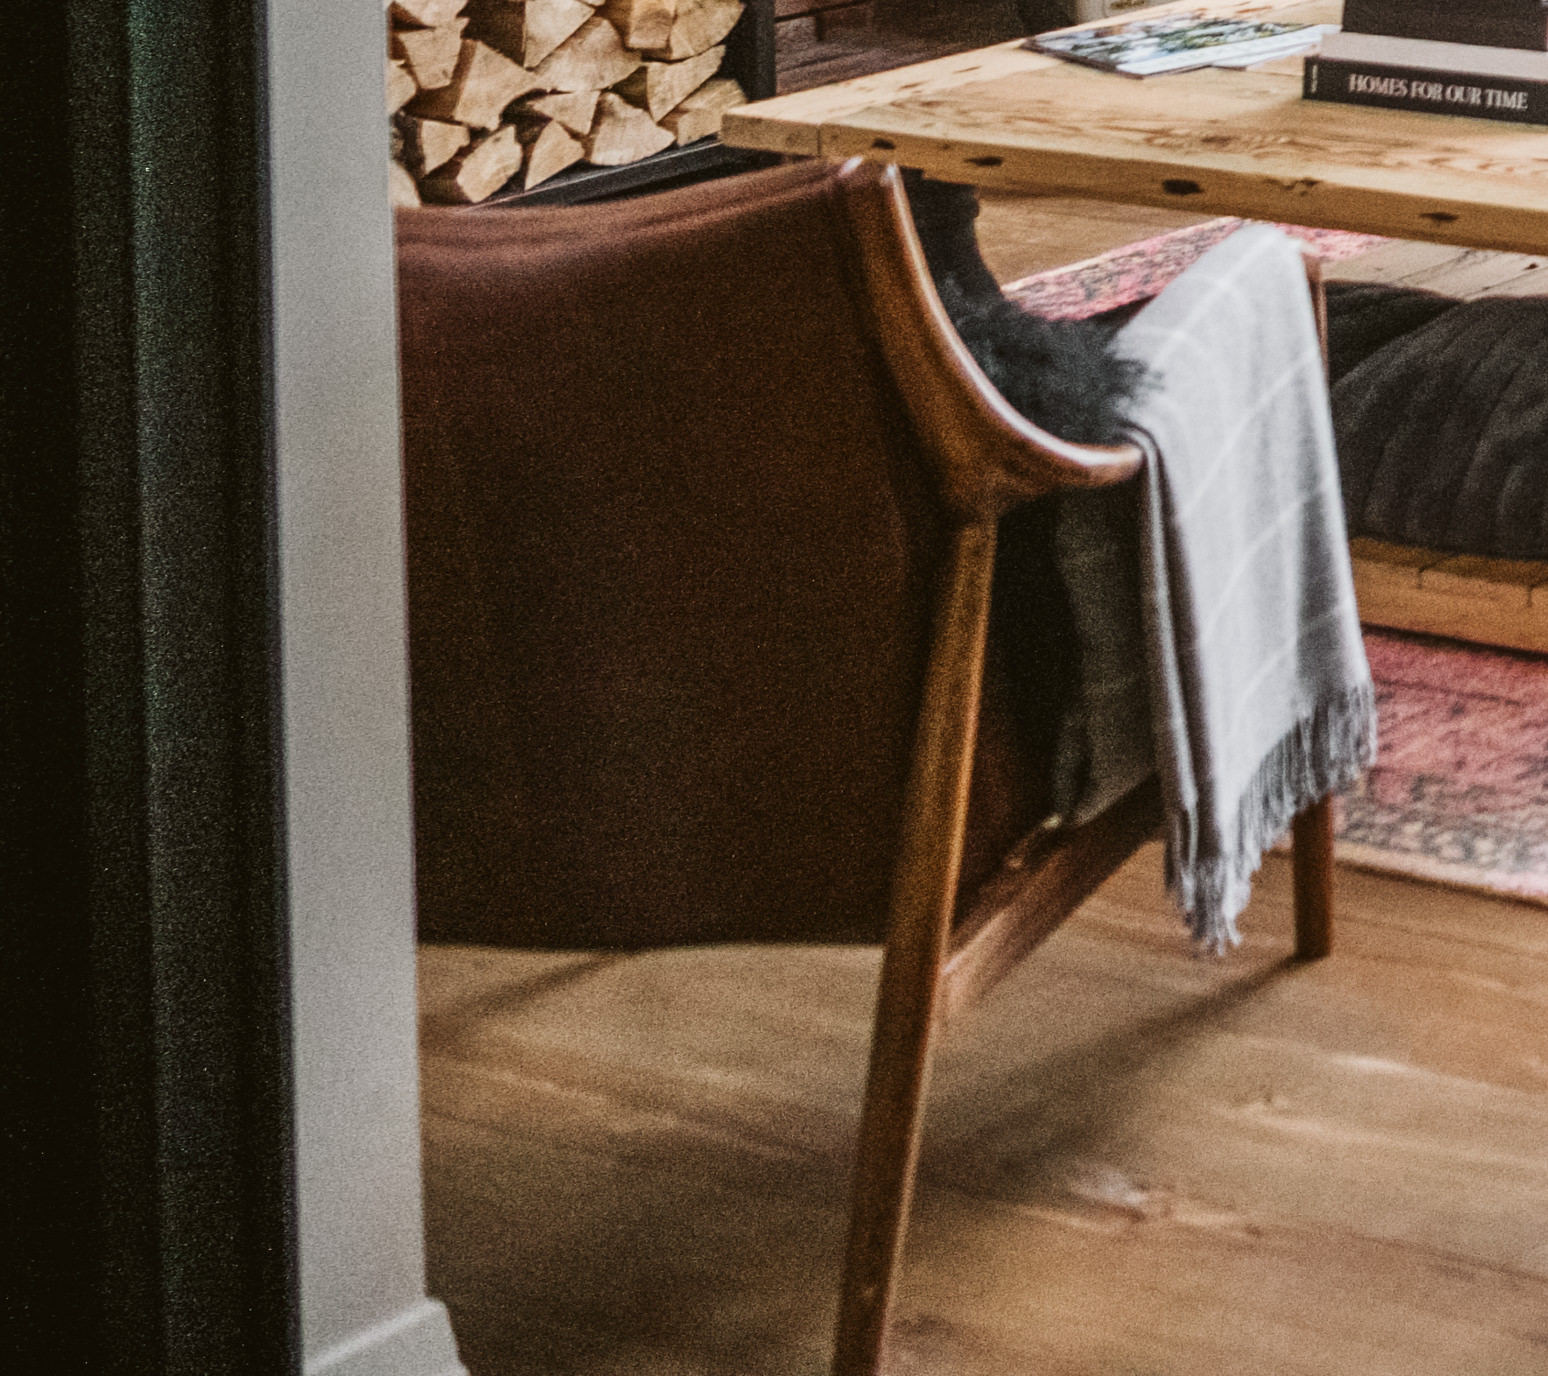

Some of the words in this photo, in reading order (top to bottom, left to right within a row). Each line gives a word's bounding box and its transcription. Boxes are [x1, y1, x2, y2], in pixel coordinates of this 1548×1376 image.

[1348, 73, 1408, 98] HOMES
[1411, 80, 1443, 101] FOR
[1445, 84, 1482, 104] OUR
[1484, 89, 1529, 110] TIME
